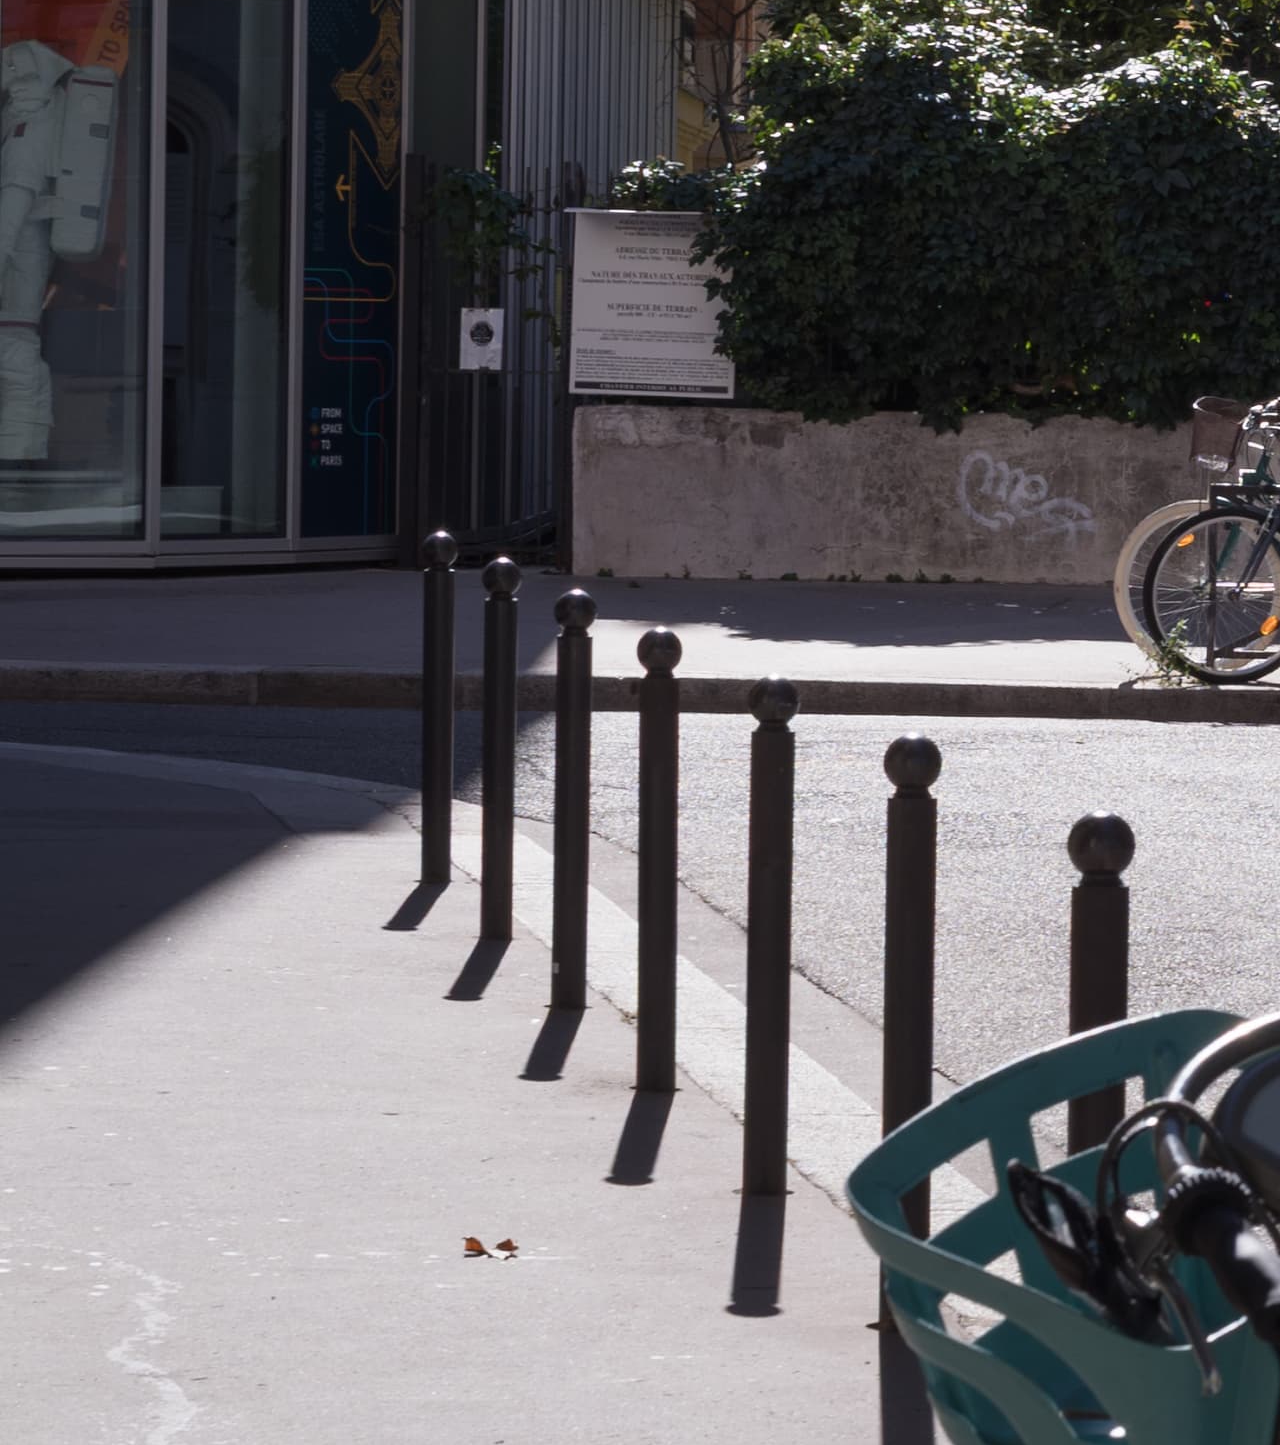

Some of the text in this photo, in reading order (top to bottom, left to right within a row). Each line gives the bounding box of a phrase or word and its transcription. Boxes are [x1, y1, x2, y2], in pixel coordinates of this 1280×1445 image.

[96, 38, 121, 63] TO
[320, 407, 342, 419] FROM
[320, 423, 343, 435] SPACE
[320, 439, 332, 451] TO
[320, 455, 343, 466] PARIS
